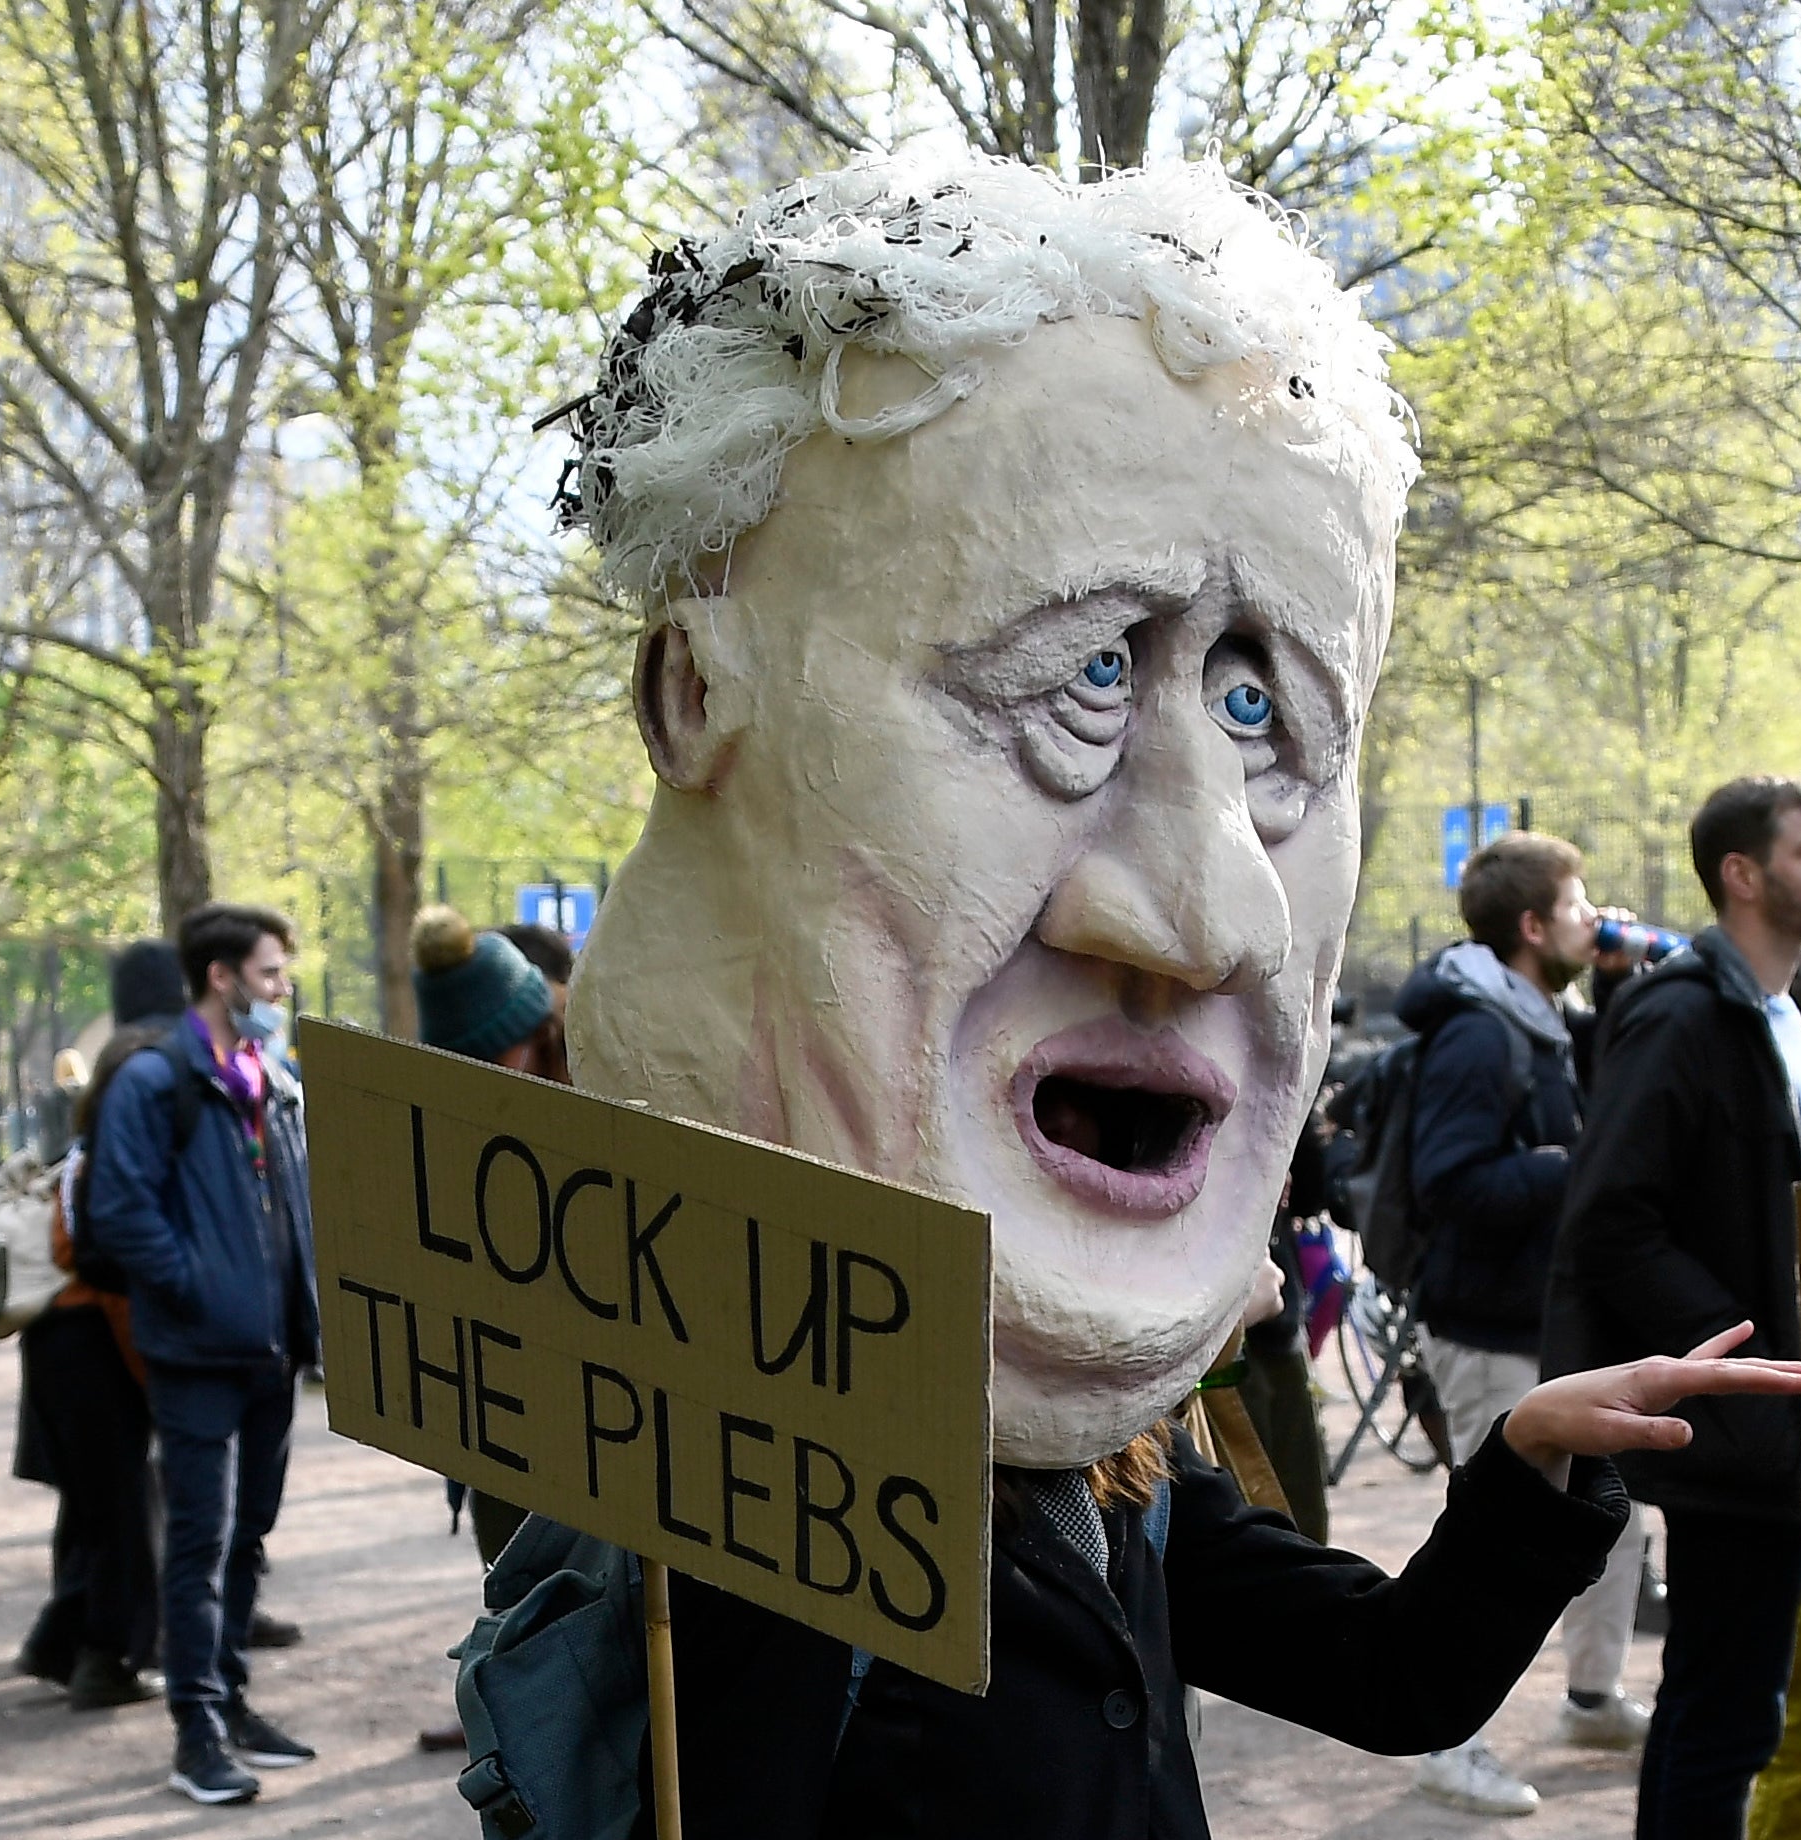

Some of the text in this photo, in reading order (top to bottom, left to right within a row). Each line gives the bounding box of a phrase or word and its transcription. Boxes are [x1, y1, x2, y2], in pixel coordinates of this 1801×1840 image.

[410, 1104, 910, 1395] LOCK UP
[338, 1277, 947, 1633] THE PLEBS
